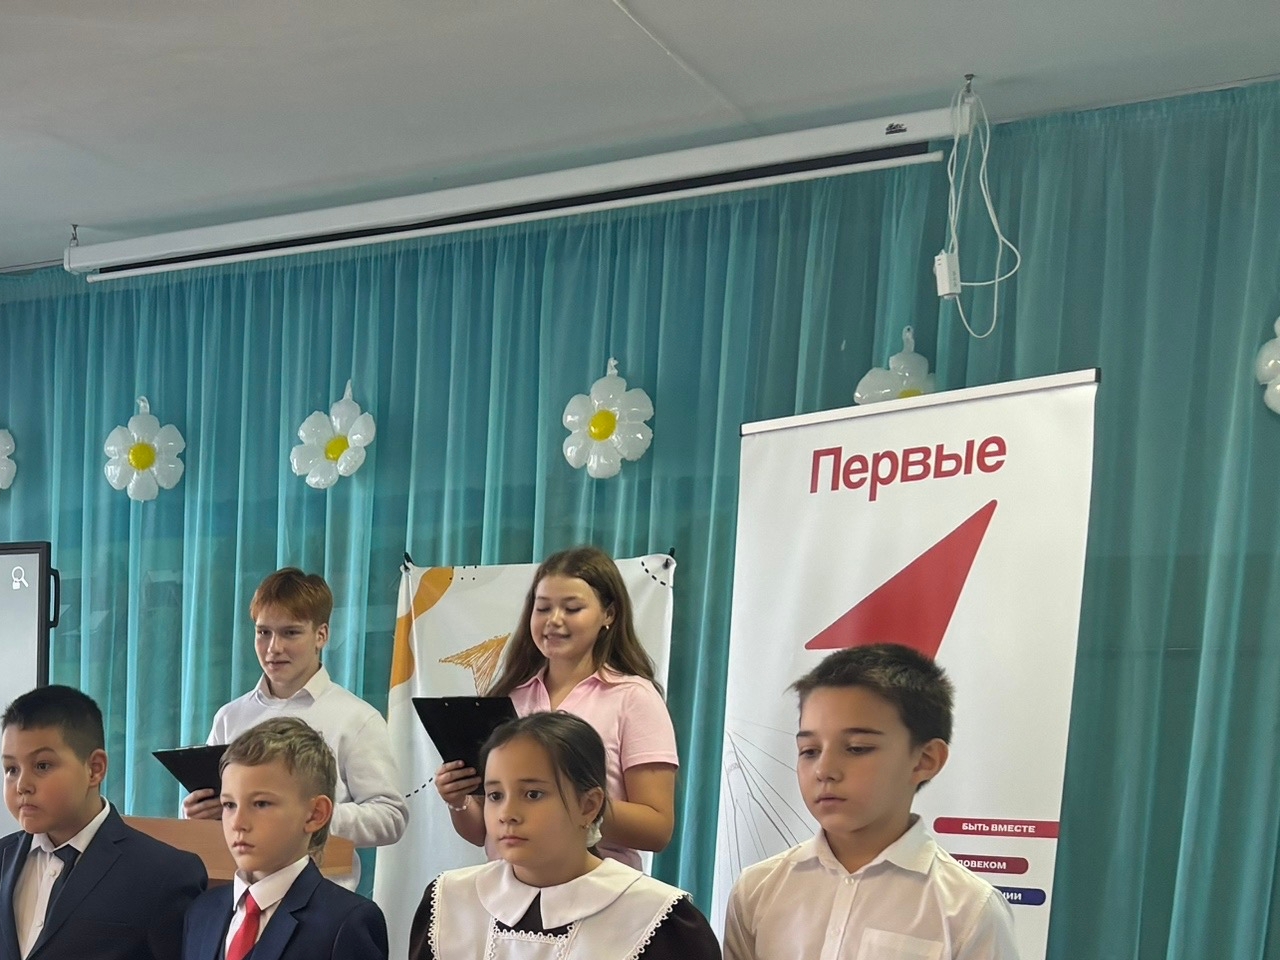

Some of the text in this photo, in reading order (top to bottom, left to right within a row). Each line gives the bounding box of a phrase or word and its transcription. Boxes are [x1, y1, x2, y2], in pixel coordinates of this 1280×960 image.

[810, 436, 1007, 502] Первые
[961, 822, 1036, 834] БЫТЬ ВМЕСТЕ
